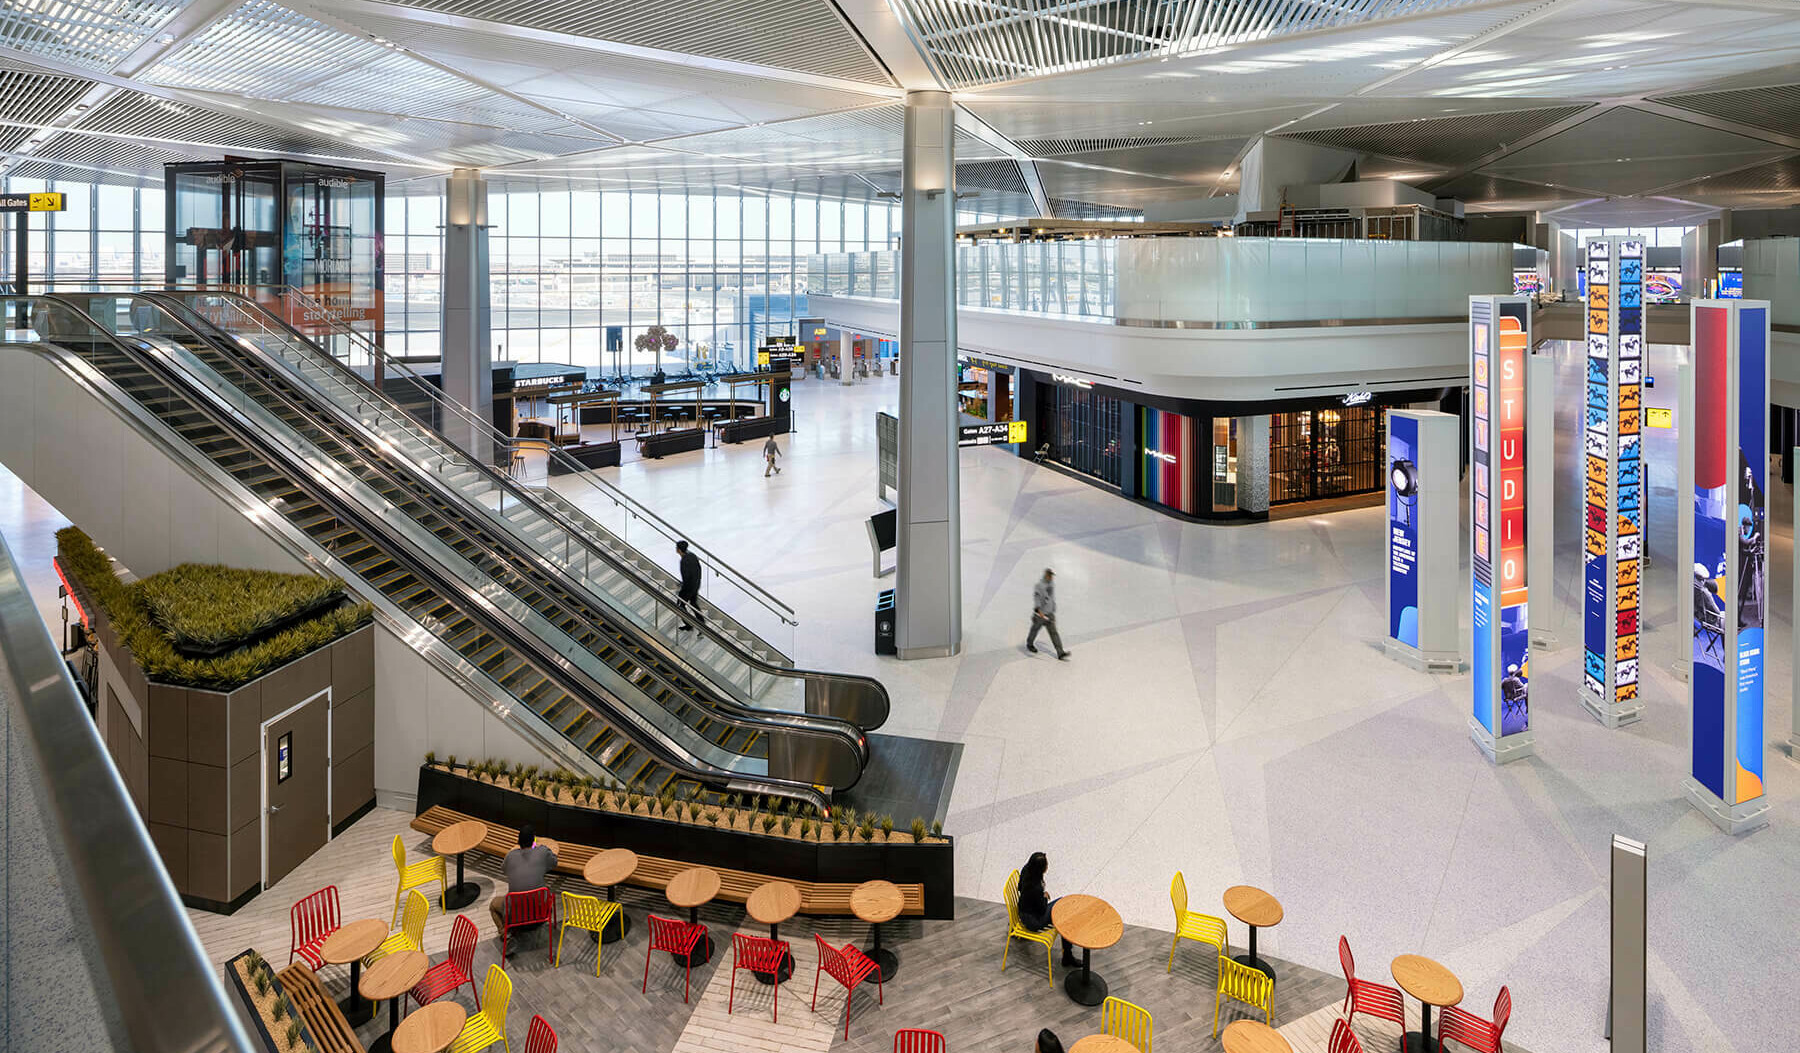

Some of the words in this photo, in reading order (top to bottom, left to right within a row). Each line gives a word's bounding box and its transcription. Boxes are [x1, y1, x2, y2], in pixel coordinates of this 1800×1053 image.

[318, 178, 349, 188] audible
[7, 199, 28, 207] Gates
[515, 376, 565, 388] STARBUCKS
[979, 424, 1009, 434] A27-A34
[1144, 447, 1176, 463] MAC
[1503, 359, 1515, 580] STUDIO
